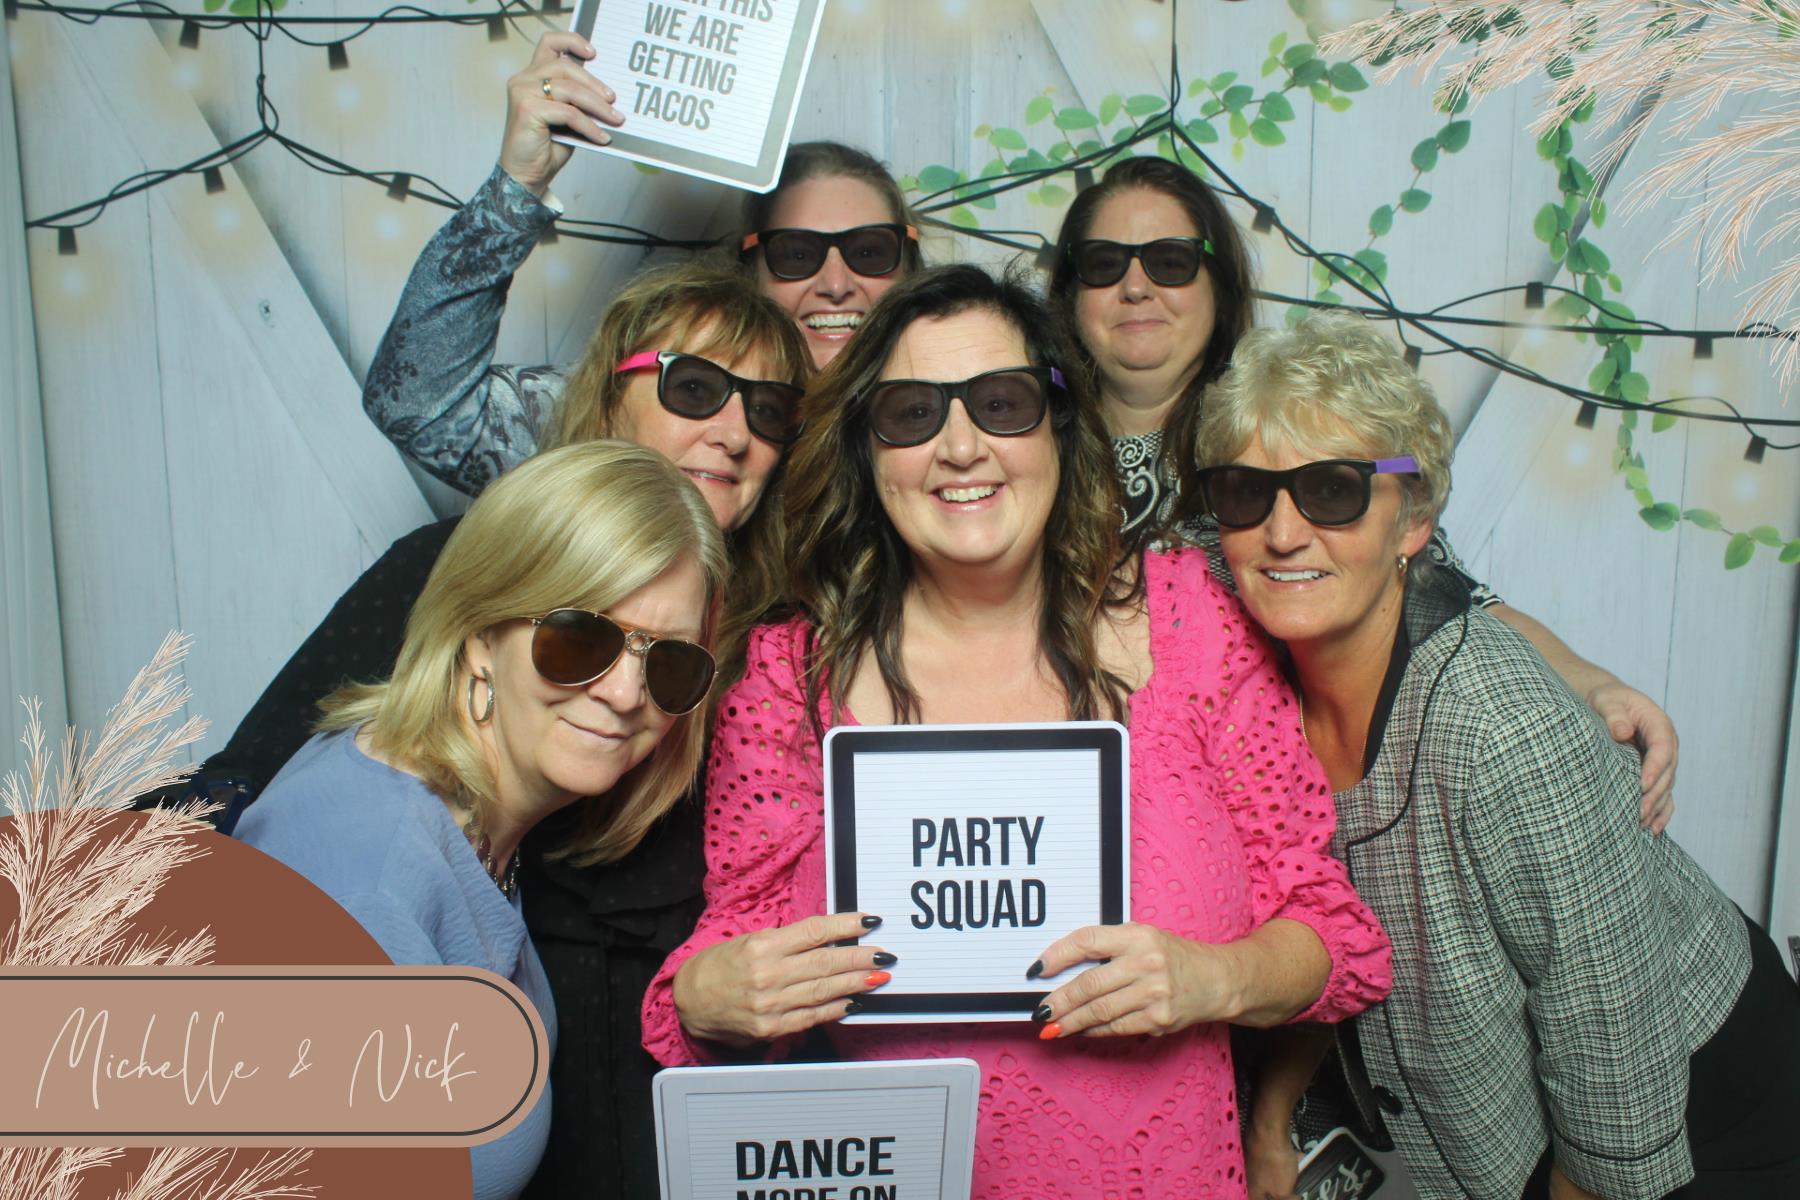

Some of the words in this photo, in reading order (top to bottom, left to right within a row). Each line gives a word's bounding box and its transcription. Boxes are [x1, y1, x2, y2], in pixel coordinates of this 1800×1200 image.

[645, 2, 687, 41] WE
[688, 15, 744, 55] ARE
[628, 40, 737, 95] GETTING
[633, 81, 714, 131] TACOS
[912, 816, 1045, 867] PARTY
[910, 878, 1046, 931] SQUAD
[735, 1136, 896, 1181] DANCE
